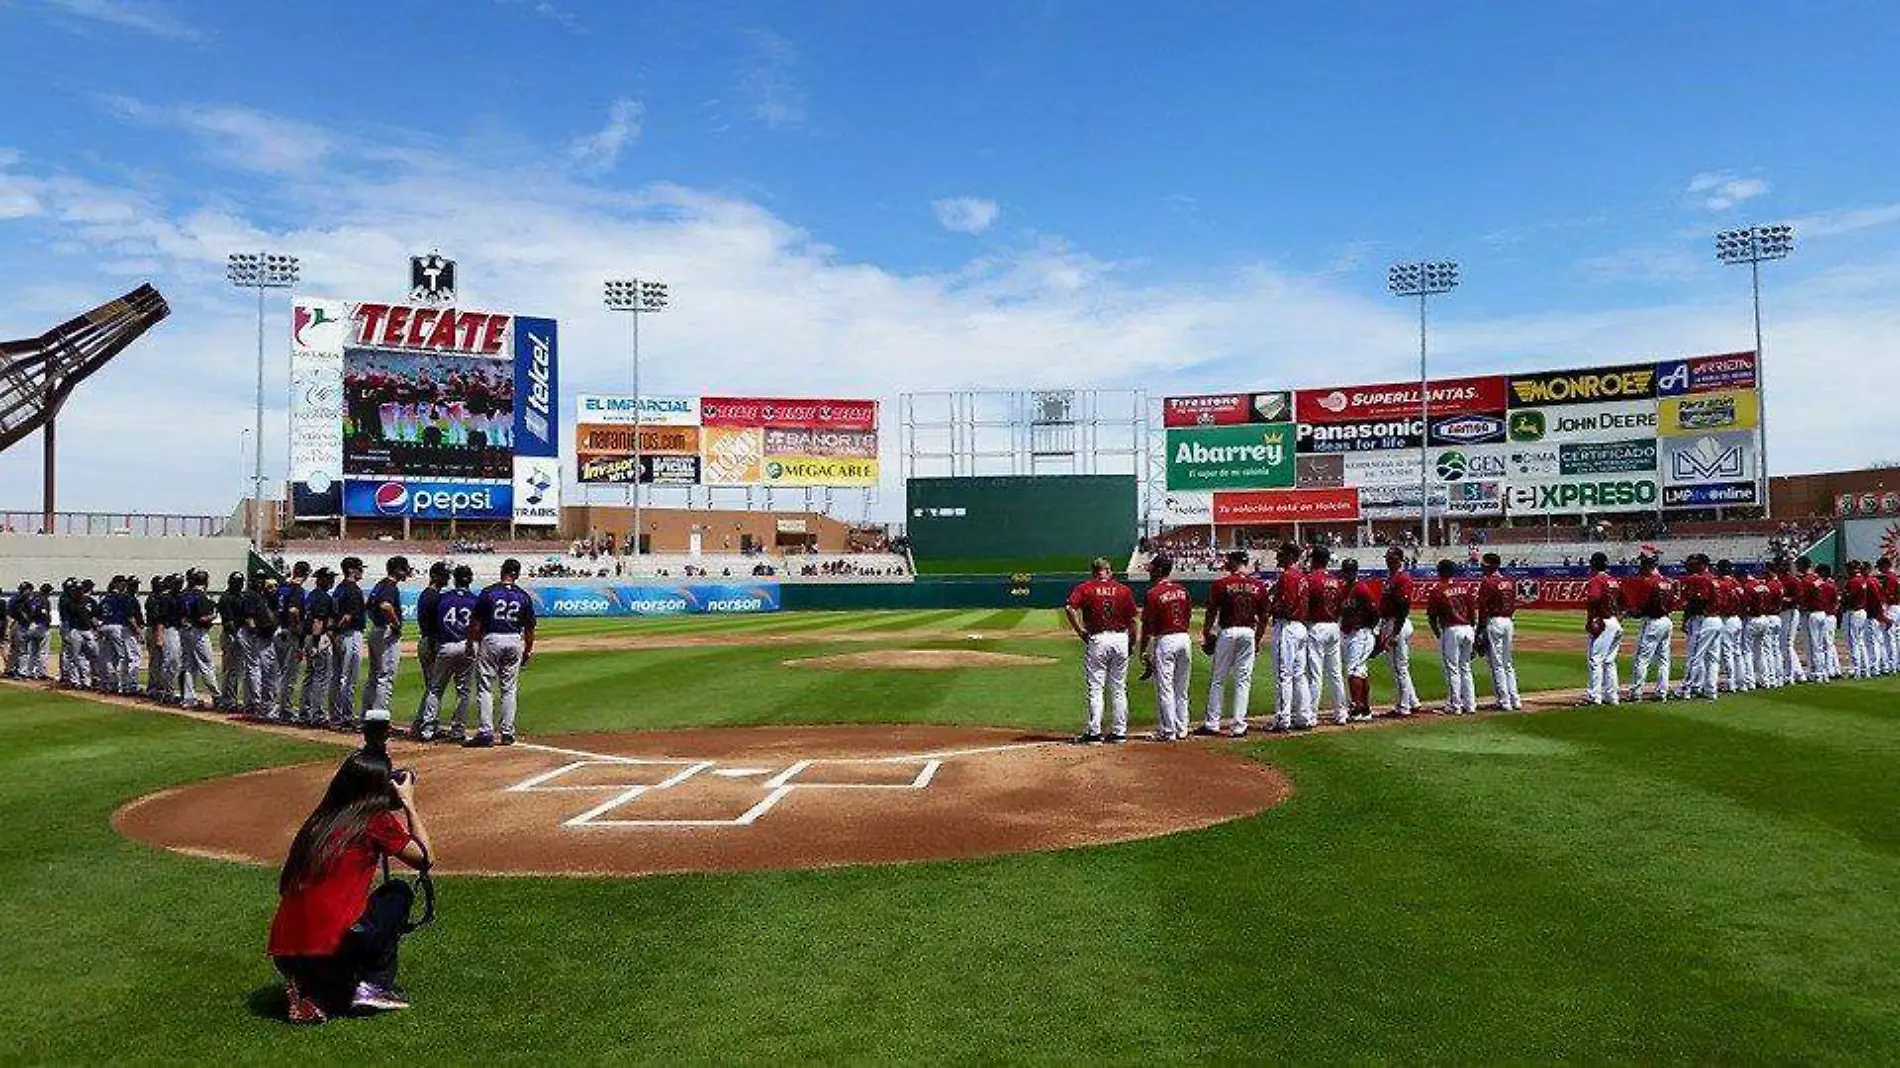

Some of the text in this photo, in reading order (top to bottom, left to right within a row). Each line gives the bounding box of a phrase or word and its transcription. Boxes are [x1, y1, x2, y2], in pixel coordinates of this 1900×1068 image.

[355, 303, 512, 354] TECATE
[527, 332, 550, 414] telcel
[1530, 371, 1640, 401] MONROE
[586, 399, 604, 410] EL
[1297, 418, 1424, 442] Panasonic
[1554, 413, 1656, 432] JOHN DEERE
[1314, 436, 1405, 451] ideas for life
[1175, 442, 1282, 466] Abarrey
[1469, 456, 1506, 471] GEN
[1561, 447, 1655, 461] CERTIFICADO
[785, 465, 872, 478] MEGACABLE
[412, 487, 493, 513] pepsi
[494, 599, 521, 621] 22
[554, 599, 610, 611] norson
[631, 599, 686, 610] norson
[707, 599, 761, 611] norson
[443, 606, 472, 627] 43
